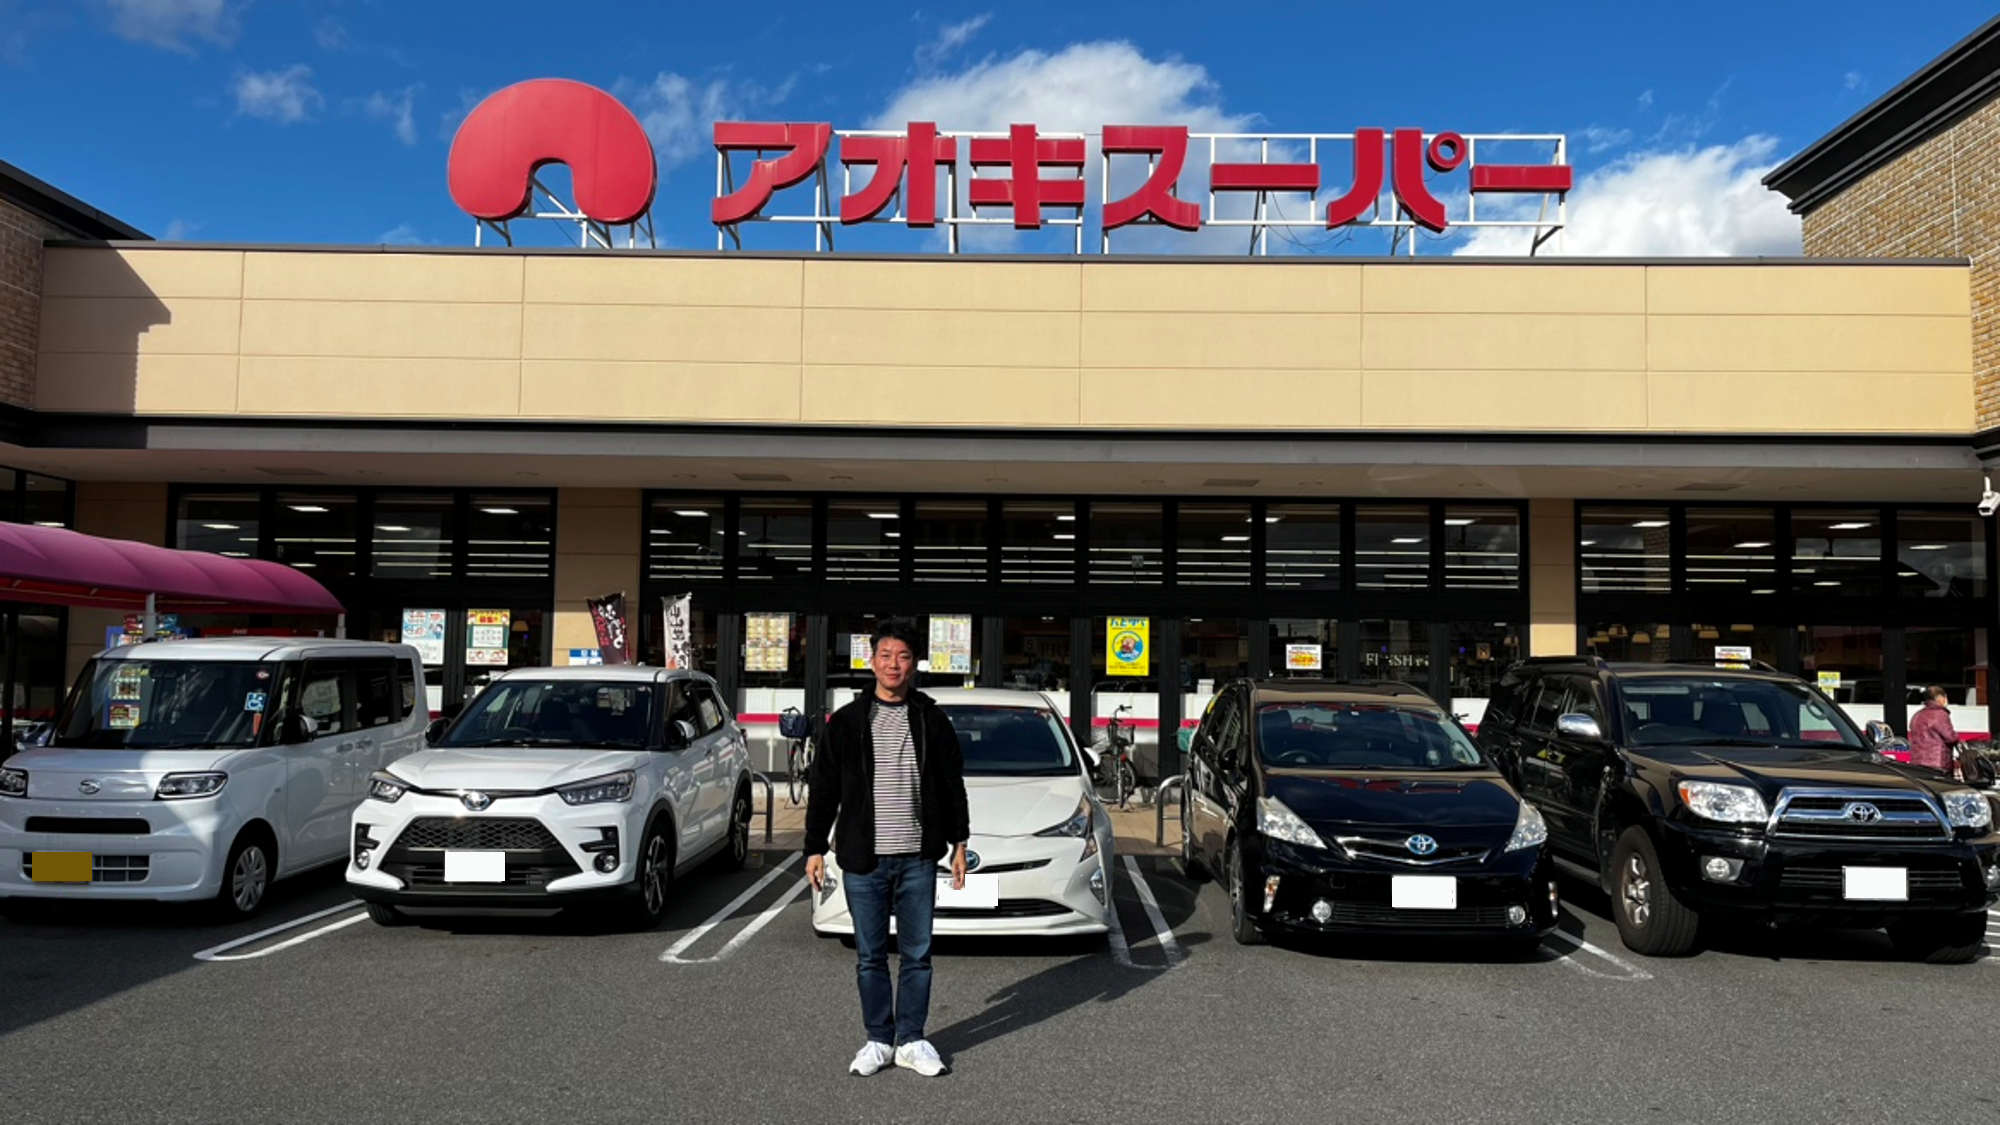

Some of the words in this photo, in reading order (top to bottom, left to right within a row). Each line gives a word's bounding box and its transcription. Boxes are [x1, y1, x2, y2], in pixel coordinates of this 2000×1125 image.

[711, 122, 1572, 233] アオキスーパー
